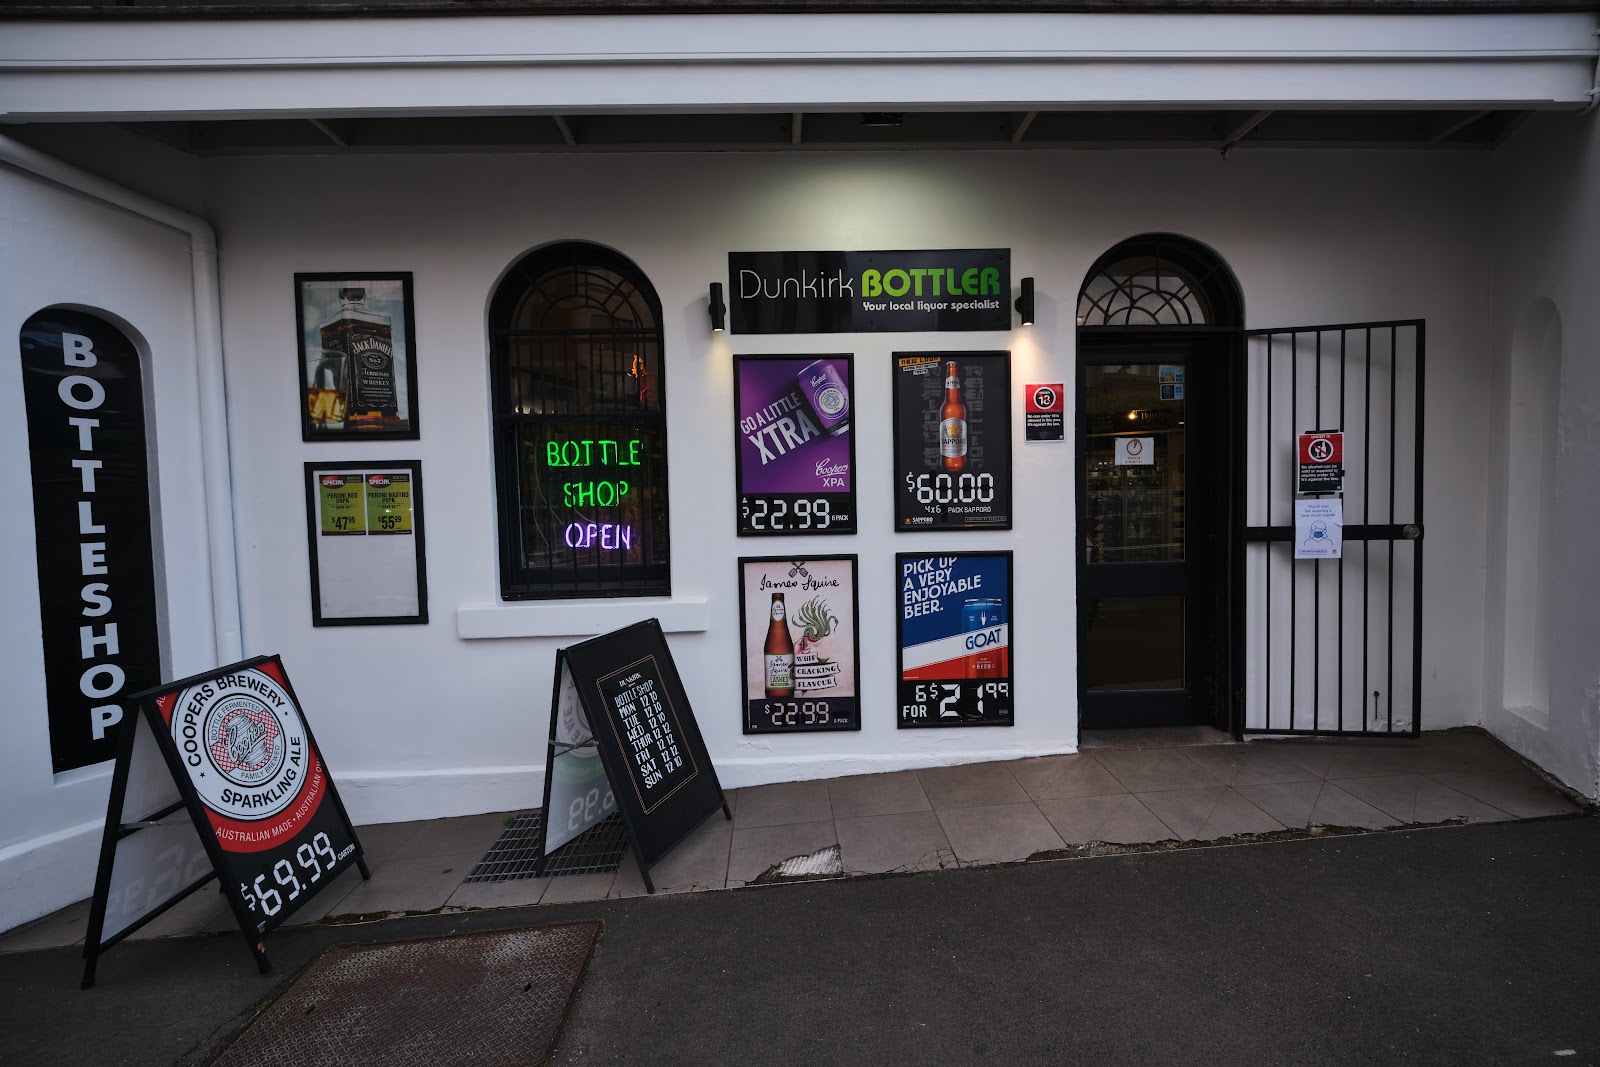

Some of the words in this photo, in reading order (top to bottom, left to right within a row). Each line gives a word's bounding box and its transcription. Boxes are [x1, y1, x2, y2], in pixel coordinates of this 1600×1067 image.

[739, 268, 854, 299] Dunkirk
[861, 267, 1001, 298] BOTTLER
[863, 301, 886, 311] Your
[890, 300, 914, 311] local
[917, 300, 948, 312] liquor
[950, 300, 1000, 312] specialist
[352, 340, 370, 355] JACK
[740, 416, 758, 435] GO
[755, 411, 766, 427] A
[762, 391, 802, 422] LITTLE
[748, 408, 820, 466] XTRA
[547, 440, 640, 466] BOTTLE
[564, 480, 629, 508] SHOP
[822, 478, 844, 487] XPA
[906, 471, 994, 504] $60.00
[565, 522, 631, 550] OPEN
[903, 578, 914, 591] A
[918, 568, 952, 584] VERY
[904, 558, 934, 578] PICK
[760, 574, 798, 591] James
[801, 574, 840, 591] Squire
[904, 574, 982, 606] ENJOYABLE
[904, 600, 944, 620] BEER.
[966, 628, 1002, 650] GOAT
[797, 665, 836, 675] CRACKING
[798, 678, 833, 688] FLAVOUR
[619, 702, 636, 718] MON
[640, 694, 650, 707] 12
[649, 691, 658, 703] 10
[916, 684, 926, 702] 6
[182, 684, 215, 767] COOPERS
[216, 674, 286, 708] BREWERY
[211, 711, 223, 741] BOTTLE
[221, 701, 260, 714] FERMENTED
[623, 713, 641, 729] TUE
[644, 706, 654, 718] 12
[653, 702, 662, 714] 10
[903, 704, 928, 718] FOR
[627, 724, 644, 742] WED
[648, 717, 658, 729] 12
[657, 712, 666, 724] 10
[631, 733, 653, 752] THUR
[652, 728, 662, 740] 12
[662, 722, 671, 734] 12
[240, 771, 264, 780] FAMILY
[264, 744, 280, 774] BREWED
[635, 748, 651, 765] FRI
[657, 739, 666, 751] 12
[666, 733, 675, 745] 12
[640, 758, 657, 777] SAT
[661, 750, 671, 762] 12
[670, 745, 679, 757] 12
[221, 768, 297, 808] SPARKLING
[290, 736, 301, 768] ALE
[645, 769, 663, 789] SUN
[665, 762, 675, 774] 12
[674, 756, 683, 767] 10
[216, 826, 270, 842] AUSTRALIAN
[272, 820, 293, 837] MADE
[295, 774, 321, 821] AUSTRALIAN
[240, 832, 337, 916] $69.99
